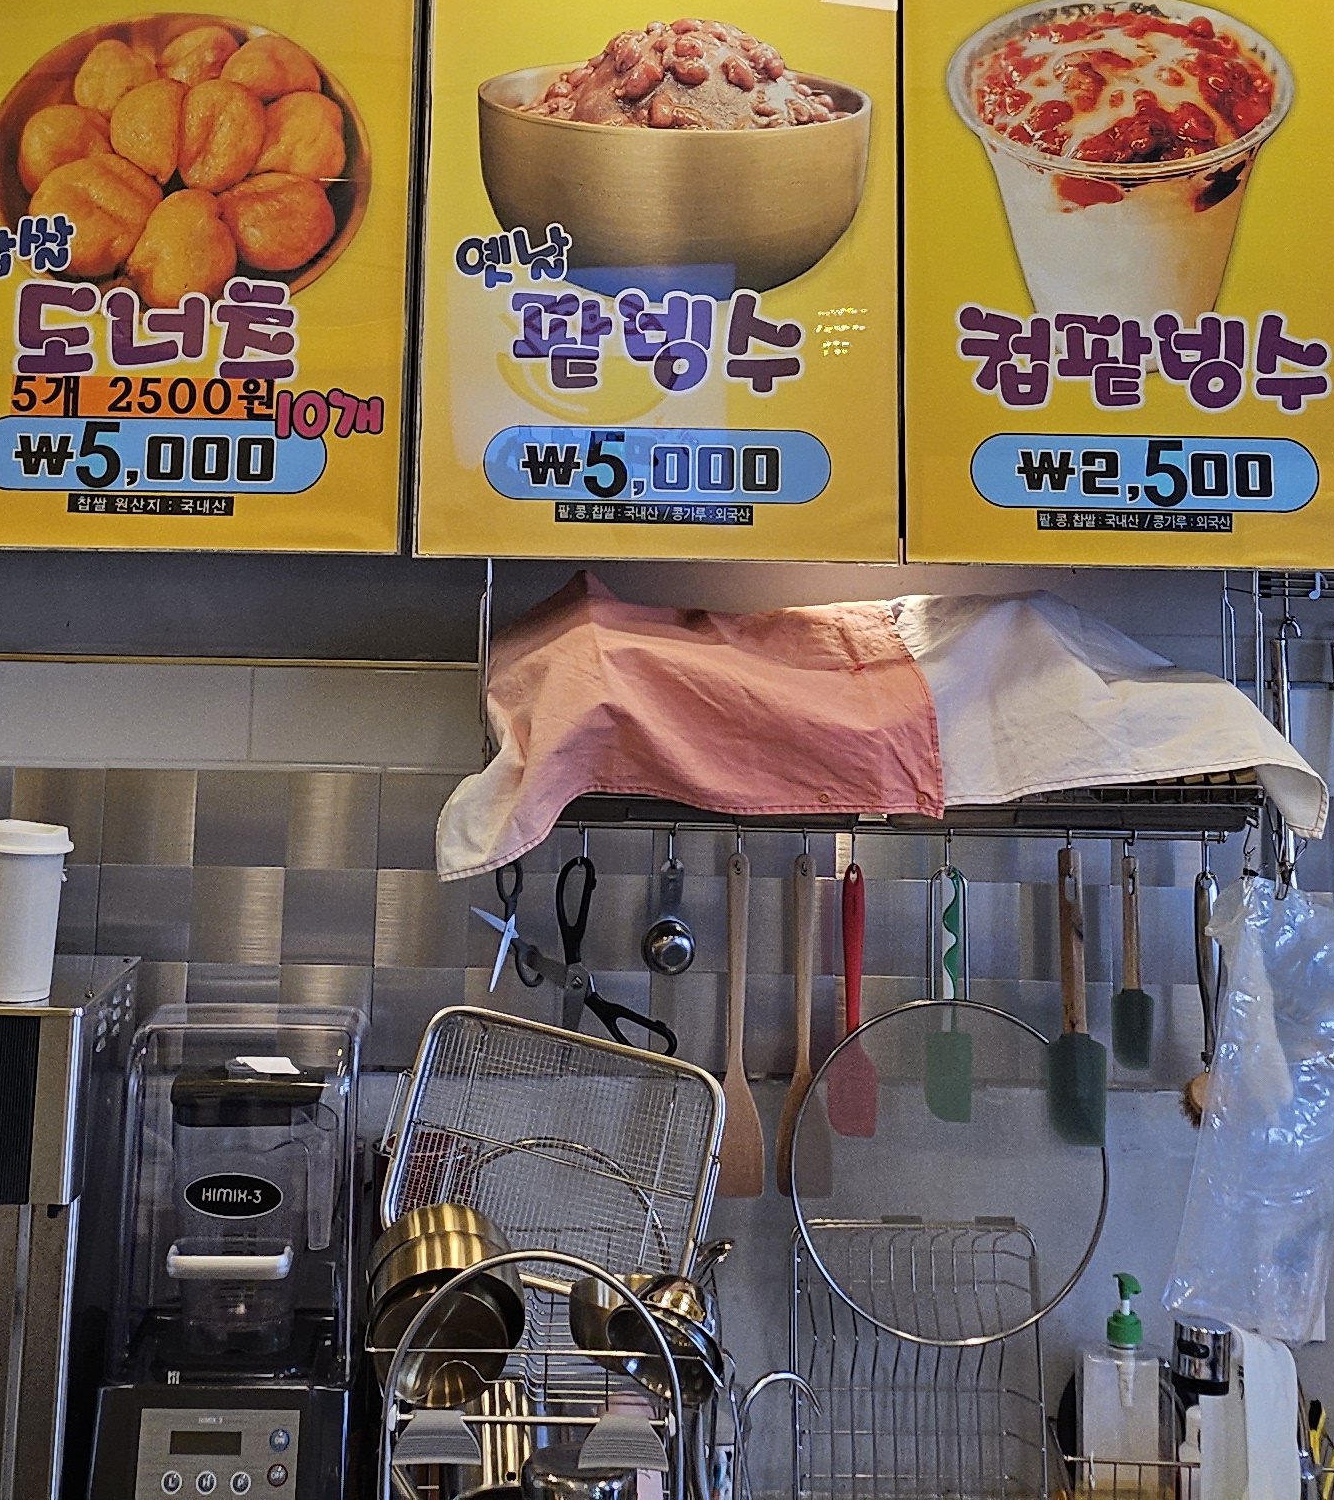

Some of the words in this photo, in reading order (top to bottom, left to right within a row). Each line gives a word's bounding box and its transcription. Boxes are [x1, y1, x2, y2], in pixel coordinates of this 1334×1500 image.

[455, 222, 572, 289] 옛날
[15, 278, 298, 380] 도너츠
[511, 289, 803, 395] 팥빙수
[958, 305, 1329, 411] 컵팥빙수
[12, 376, 80, 416] 5개
[108, 376, 275, 418] 2500원
[77, 496, 107, 512] 찹쌀
[115, 497, 160, 513] 원산지
[180, 499, 227, 514] 국내산
[202, 1188, 261, 1203] HIMIX-3
